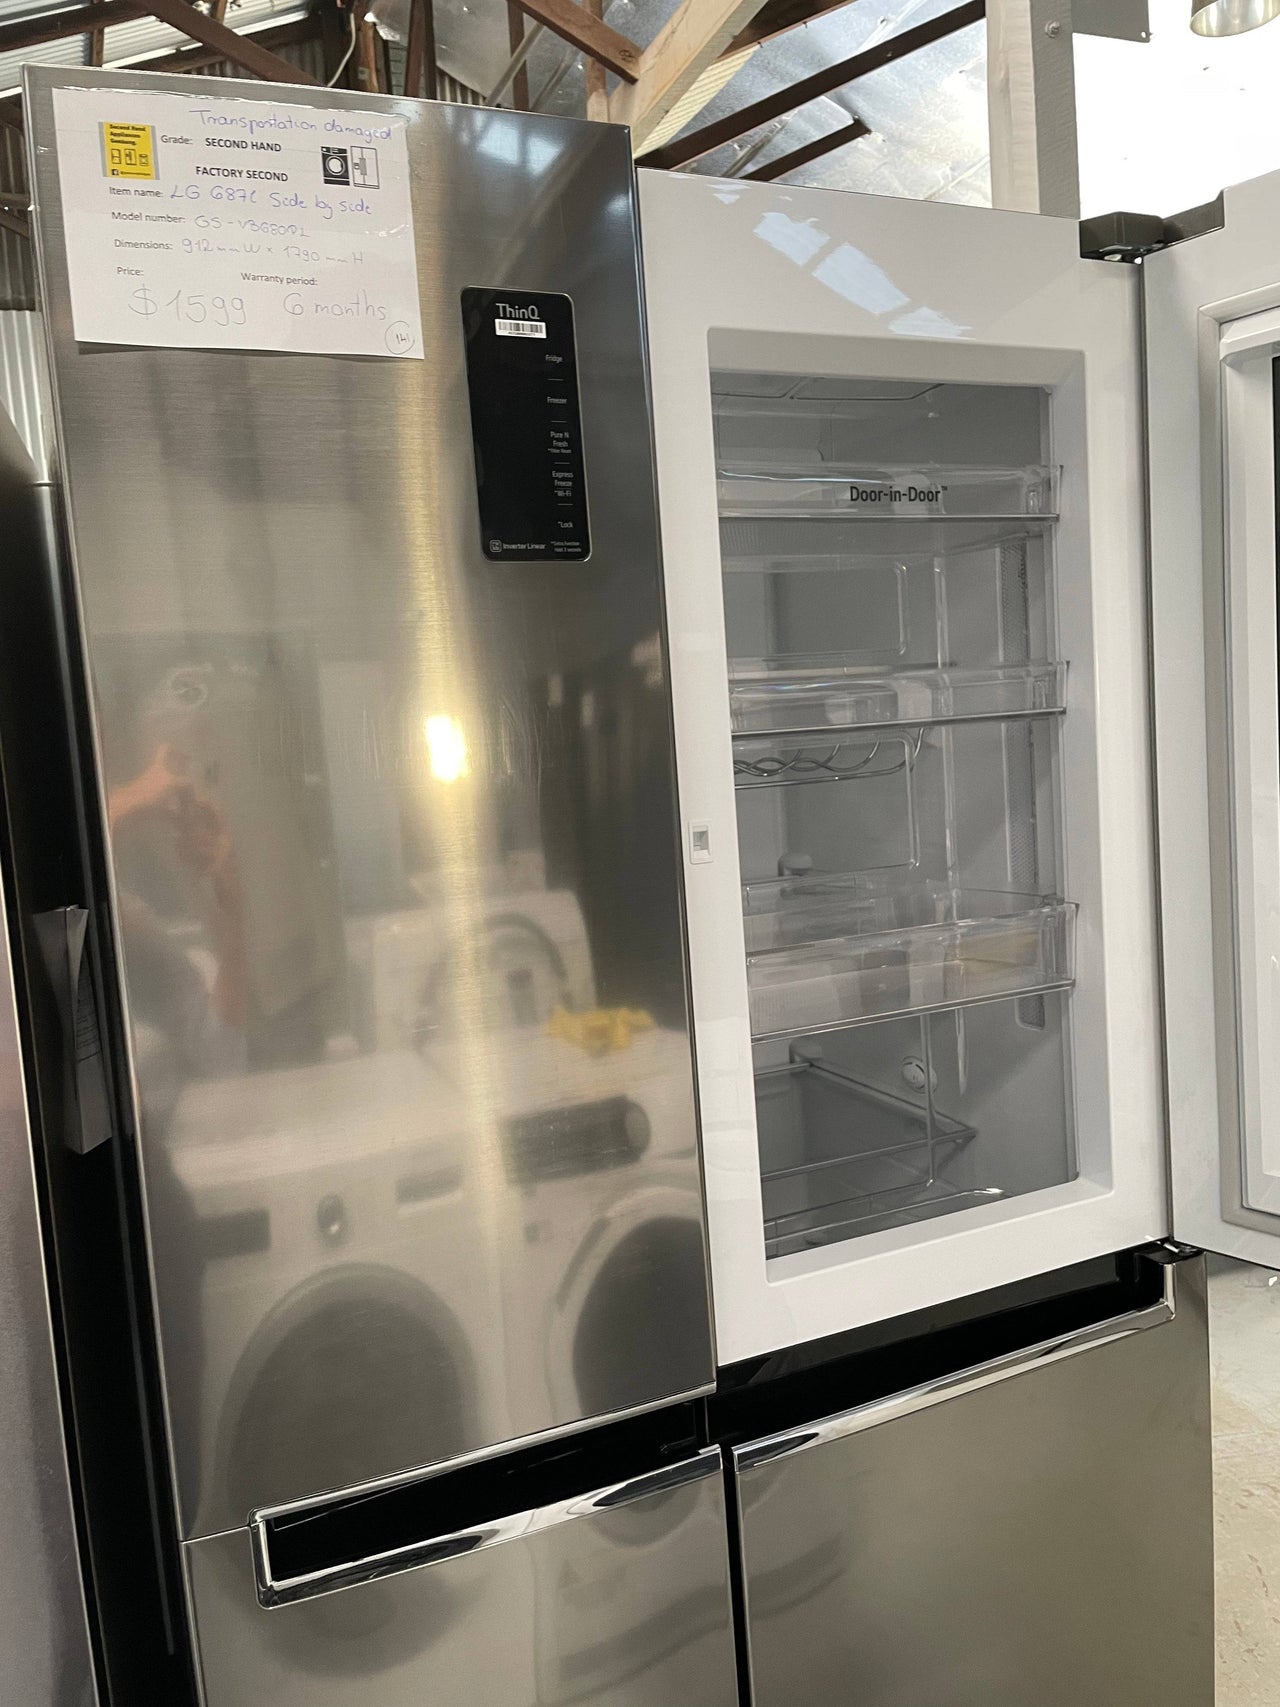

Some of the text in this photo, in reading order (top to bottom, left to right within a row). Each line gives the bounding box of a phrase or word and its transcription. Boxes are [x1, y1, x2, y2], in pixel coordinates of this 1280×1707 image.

[189, 109, 392, 143] Transportation damaged
[160, 134, 193, 145] Grade:
[205, 137, 282, 152] SECOND HAND
[195, 166, 289, 182] FACTORY SECOND
[109, 186, 164, 198] Item name:
[170, 184, 200, 200] LG
[269, 192, 307, 208] Side
[315, 194, 333, 220] by
[111, 211, 186, 224] Model number:
[114, 239, 173, 250] Dimensions:
[116, 266, 144, 277] Price:
[241, 272, 318, 286] Warranty period:
[283, 289, 387, 321] 6 months
[495, 303, 541, 320] ThinQ
